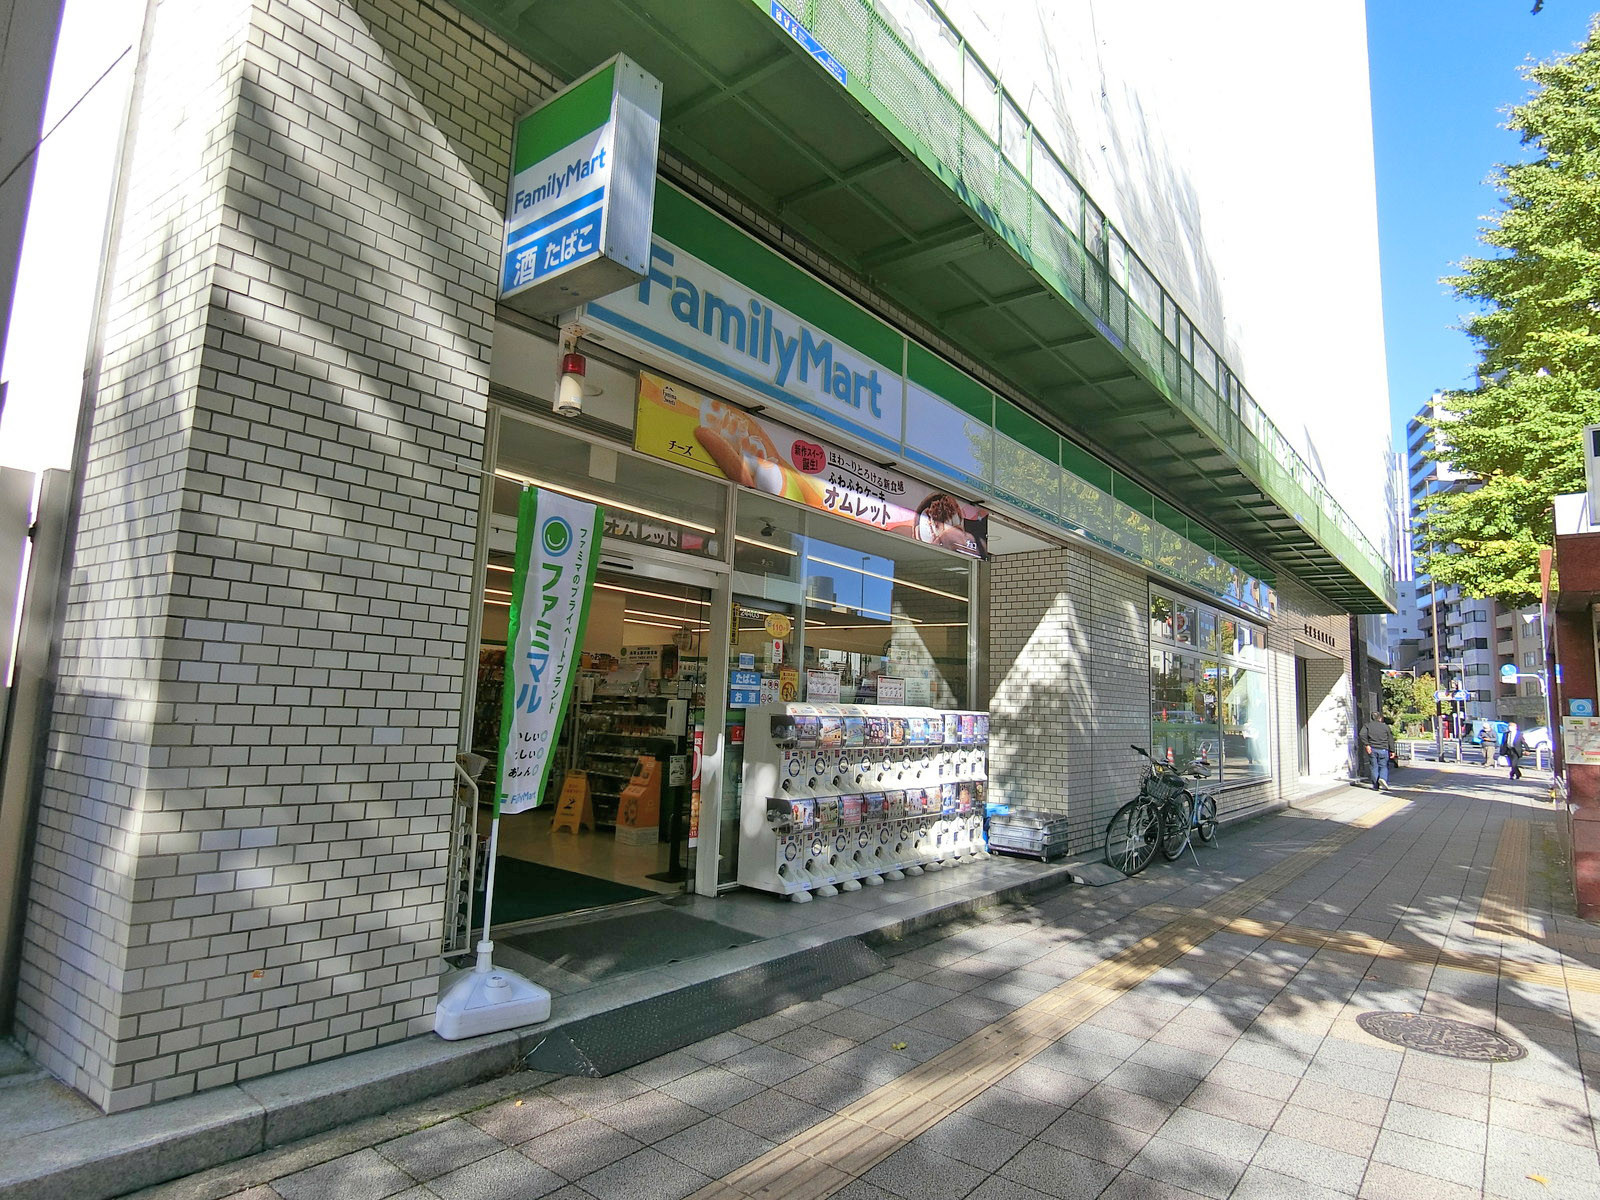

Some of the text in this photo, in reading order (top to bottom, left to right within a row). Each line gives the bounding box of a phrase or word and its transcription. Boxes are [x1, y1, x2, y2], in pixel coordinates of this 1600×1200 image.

[514, 147, 606, 214] FamilyMart
[513, 224, 594, 286] 酒 たばこ
[638, 243, 882, 419] FamilyMart
[668, 440, 693, 456] チーズ
[824, 486, 891, 525] オムレット
[828, 472, 886, 502] ふわふわケーキ
[517, 562, 564, 714] ファミマル
[548, 528, 587, 714] ファミマのプライベートブランド
[734, 691, 757, 703] お酒
[735, 672, 757, 685] たばこ
